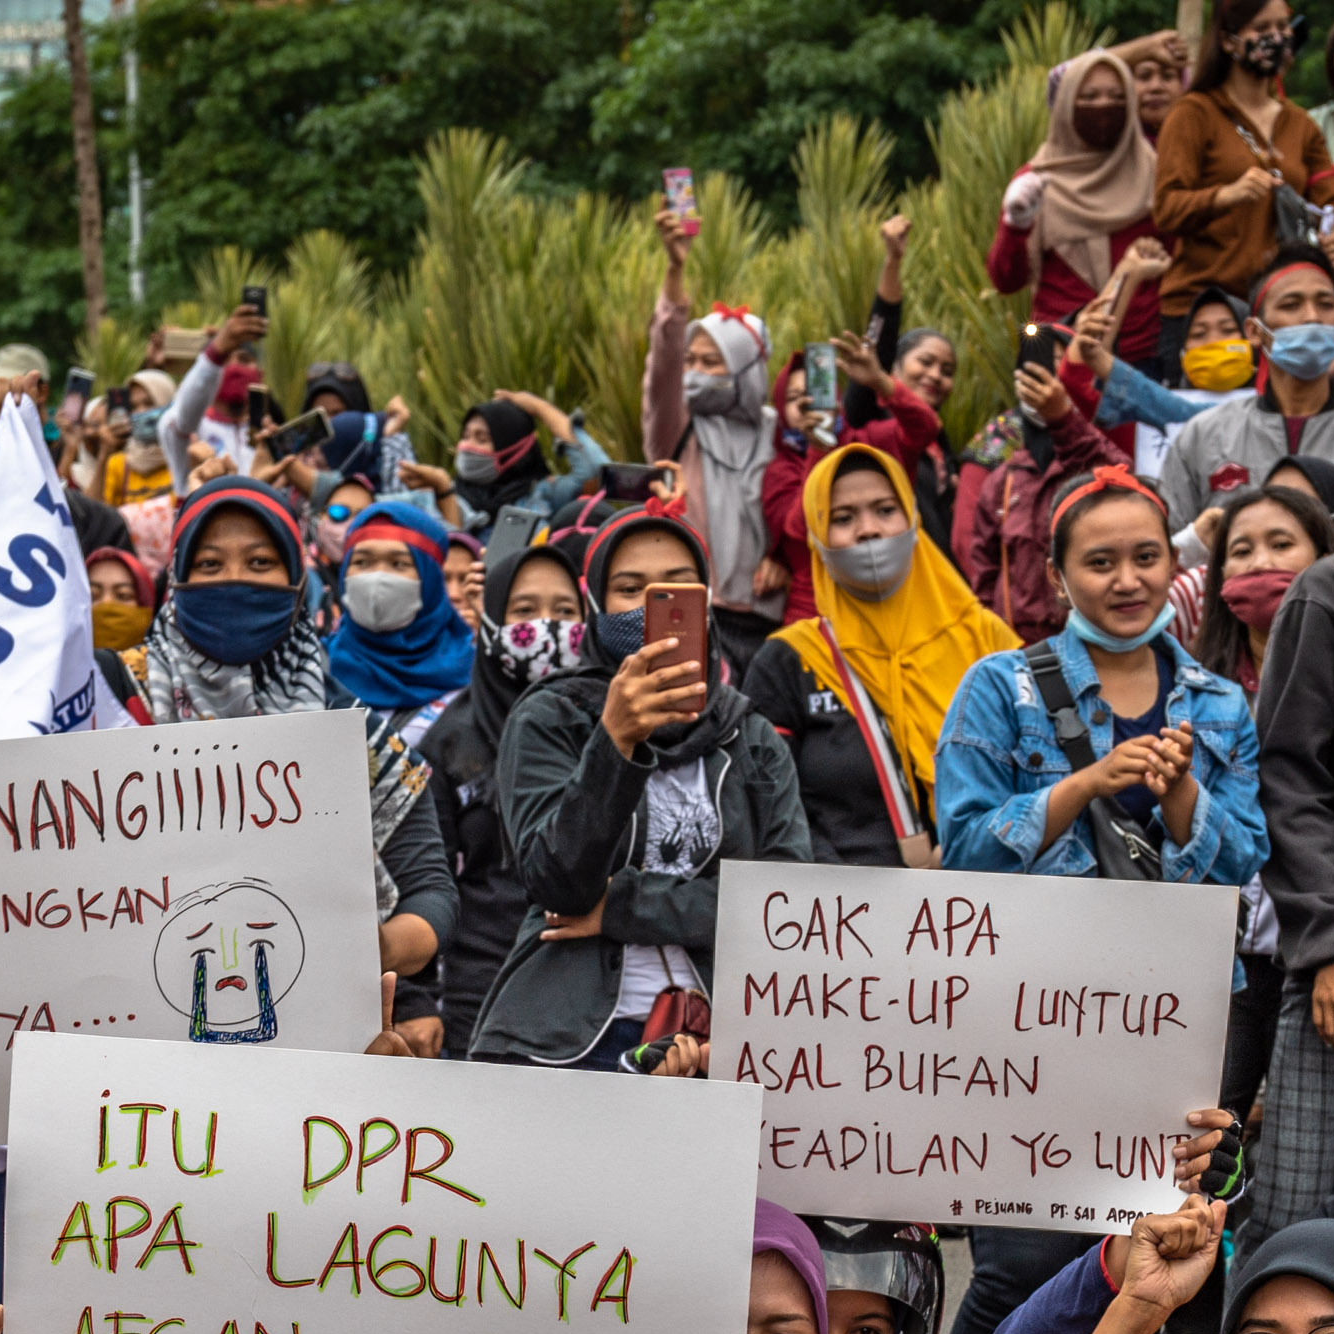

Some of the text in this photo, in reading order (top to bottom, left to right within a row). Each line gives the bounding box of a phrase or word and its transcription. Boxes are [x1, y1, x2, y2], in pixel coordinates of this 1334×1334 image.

[764, 891, 1000, 960] GAK APA
[744, 972, 1187, 1037] MAKE-UP LUNTUR
[736, 1041, 1039, 1098] ASAL BUKAN
[302, 1116, 486, 1208] DPR
[758, 1119, 989, 1179] EADILAN
[1074, 1206, 1095, 1221] SAI
[51, 1196, 636, 1324] APA LAGUNYA
